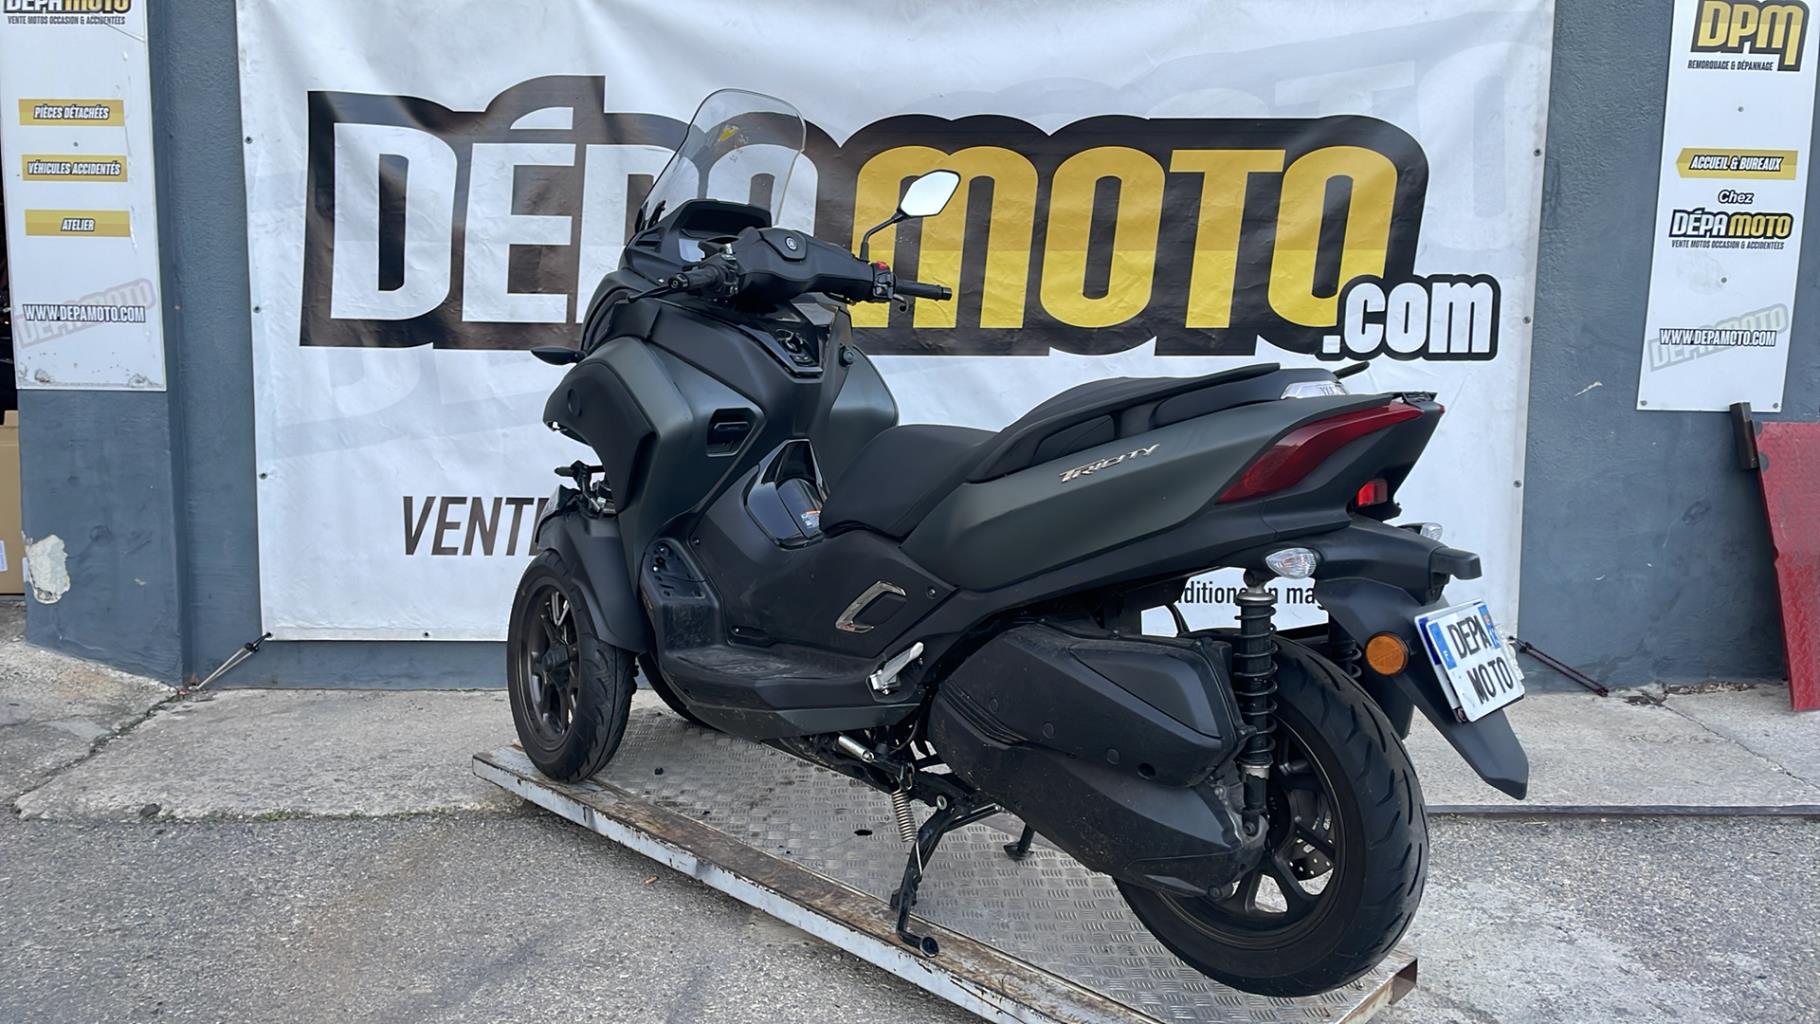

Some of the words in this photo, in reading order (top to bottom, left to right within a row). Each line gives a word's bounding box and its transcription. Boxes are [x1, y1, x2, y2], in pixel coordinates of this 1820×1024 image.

[8, 15, 26, 24] VENTE
[28, 15, 48, 24] MOTOS
[49, 15, 79, 24] OCCASION
[1694, 0, 1805, 68] DPM
[1688, 59, 1730, 70] REMORQUAGE
[1737, 60, 1774, 71] DÉPANNAGE
[63, 104, 110, 120] DÉTACHÉES
[28, 160, 71, 175] VÉHICULES
[71, 160, 121, 176] ACCIDENTÉS
[1689, 155, 1729, 170] ACCUEIL
[1730, 156, 1739, 170] &
[1739, 156, 1784, 172] BUREAUX
[1718, 189, 1754, 204] Chez
[60, 218, 96, 232] ATELIER
[1671, 239, 1689, 249] VENTE
[1691, 240, 1710, 249] MOTOS
[1711, 240, 1740, 249] OCCASION
[23, 304, 145, 323] WWW.DEPAMOTO.COM
[1660, 328, 1777, 346] WWW.DEPAMOTO.COM
[1180, 581, 1247, 604] dition
[1286, 587, 1315, 604] ma
[1446, 615, 1493, 660] DEPA
[1466, 656, 1514, 705] MOTO
